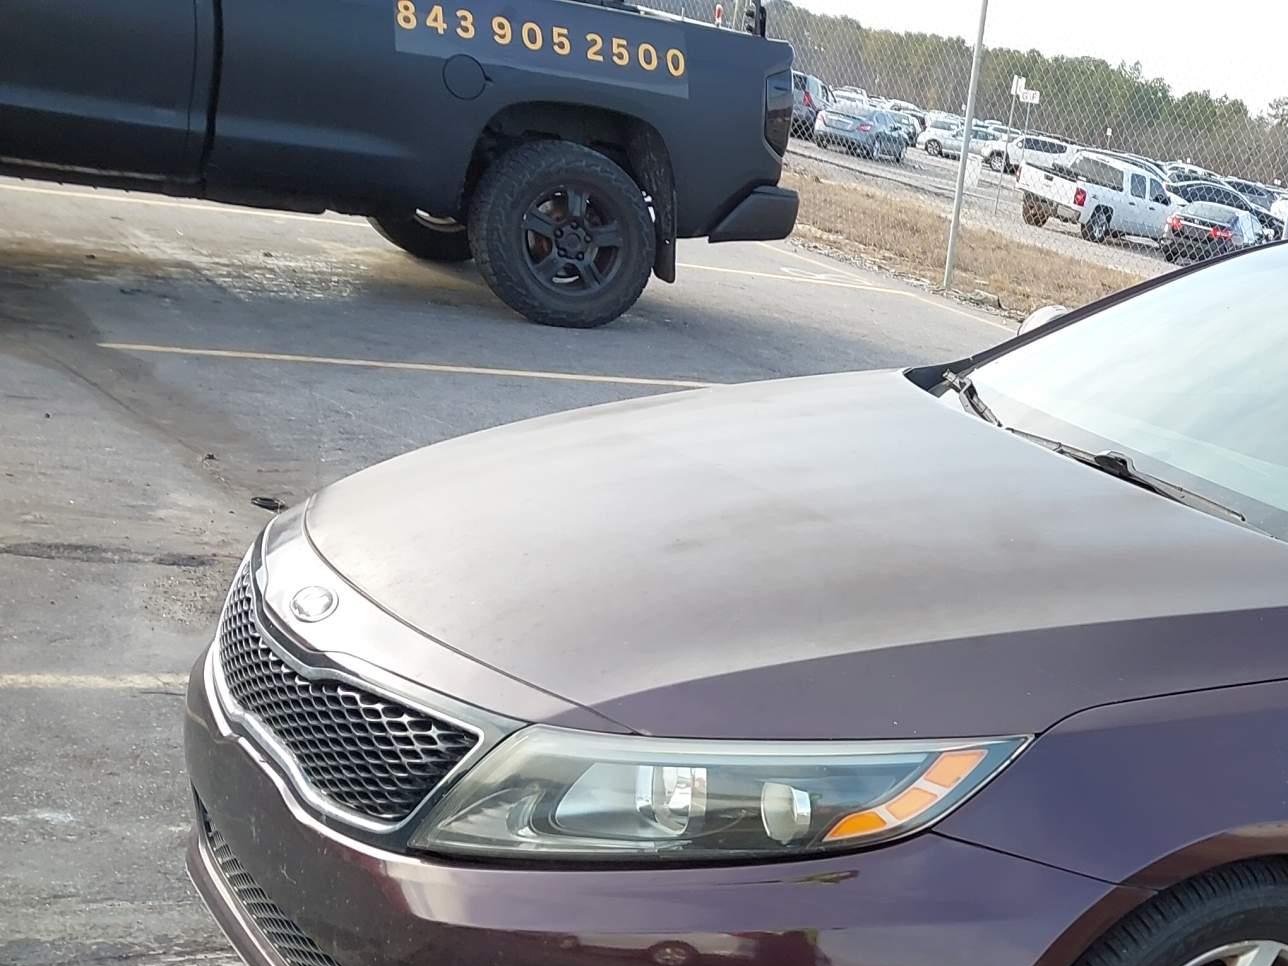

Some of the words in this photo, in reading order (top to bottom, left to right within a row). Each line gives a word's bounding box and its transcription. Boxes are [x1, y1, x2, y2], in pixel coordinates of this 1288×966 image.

[396, 0, 475, 39] 843
[491, 16, 570, 55] 905
[584, 33, 686, 77] 2500
